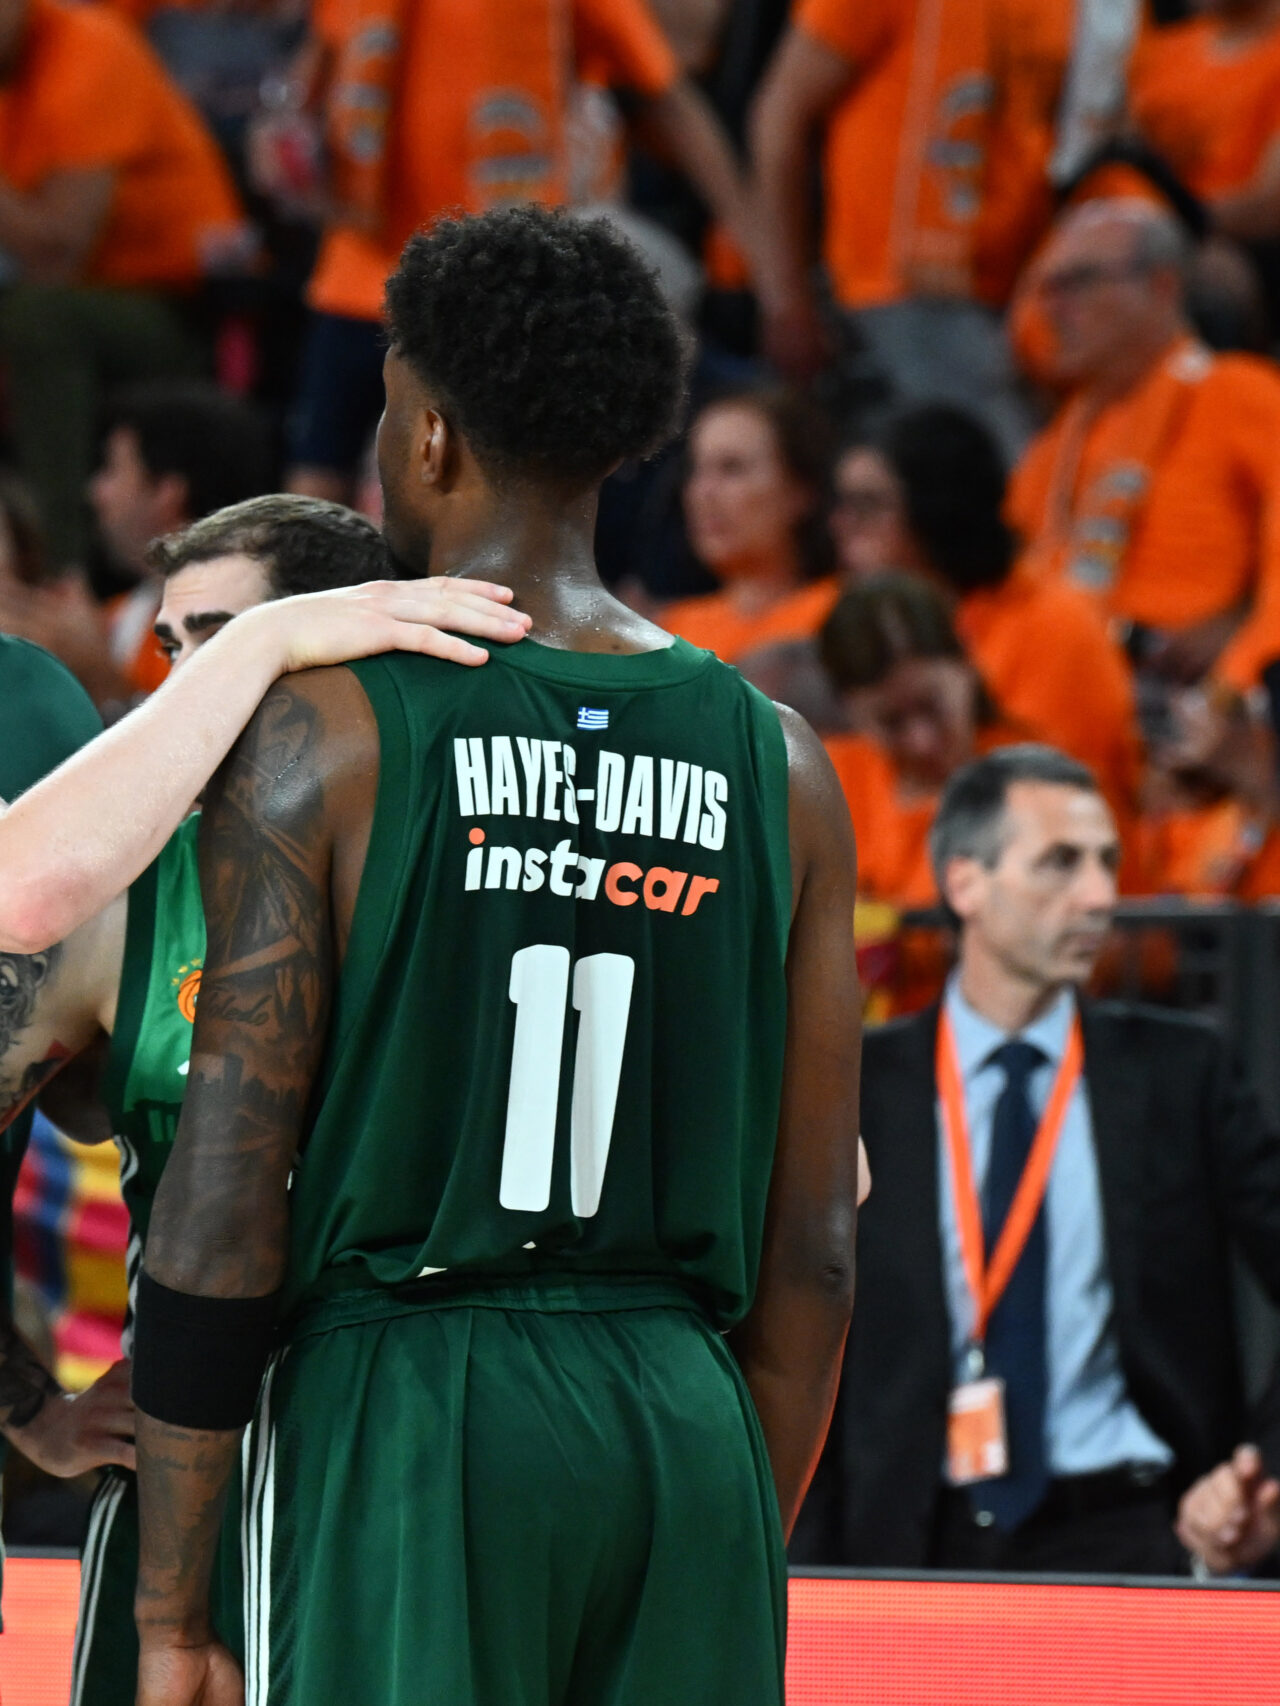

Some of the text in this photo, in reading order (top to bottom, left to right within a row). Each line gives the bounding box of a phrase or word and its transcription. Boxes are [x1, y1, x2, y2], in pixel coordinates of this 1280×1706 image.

[454, 735, 728, 851] HAYES-DAVIS
[464, 827, 720, 916] instacar
[499, 944, 635, 1218] 11
